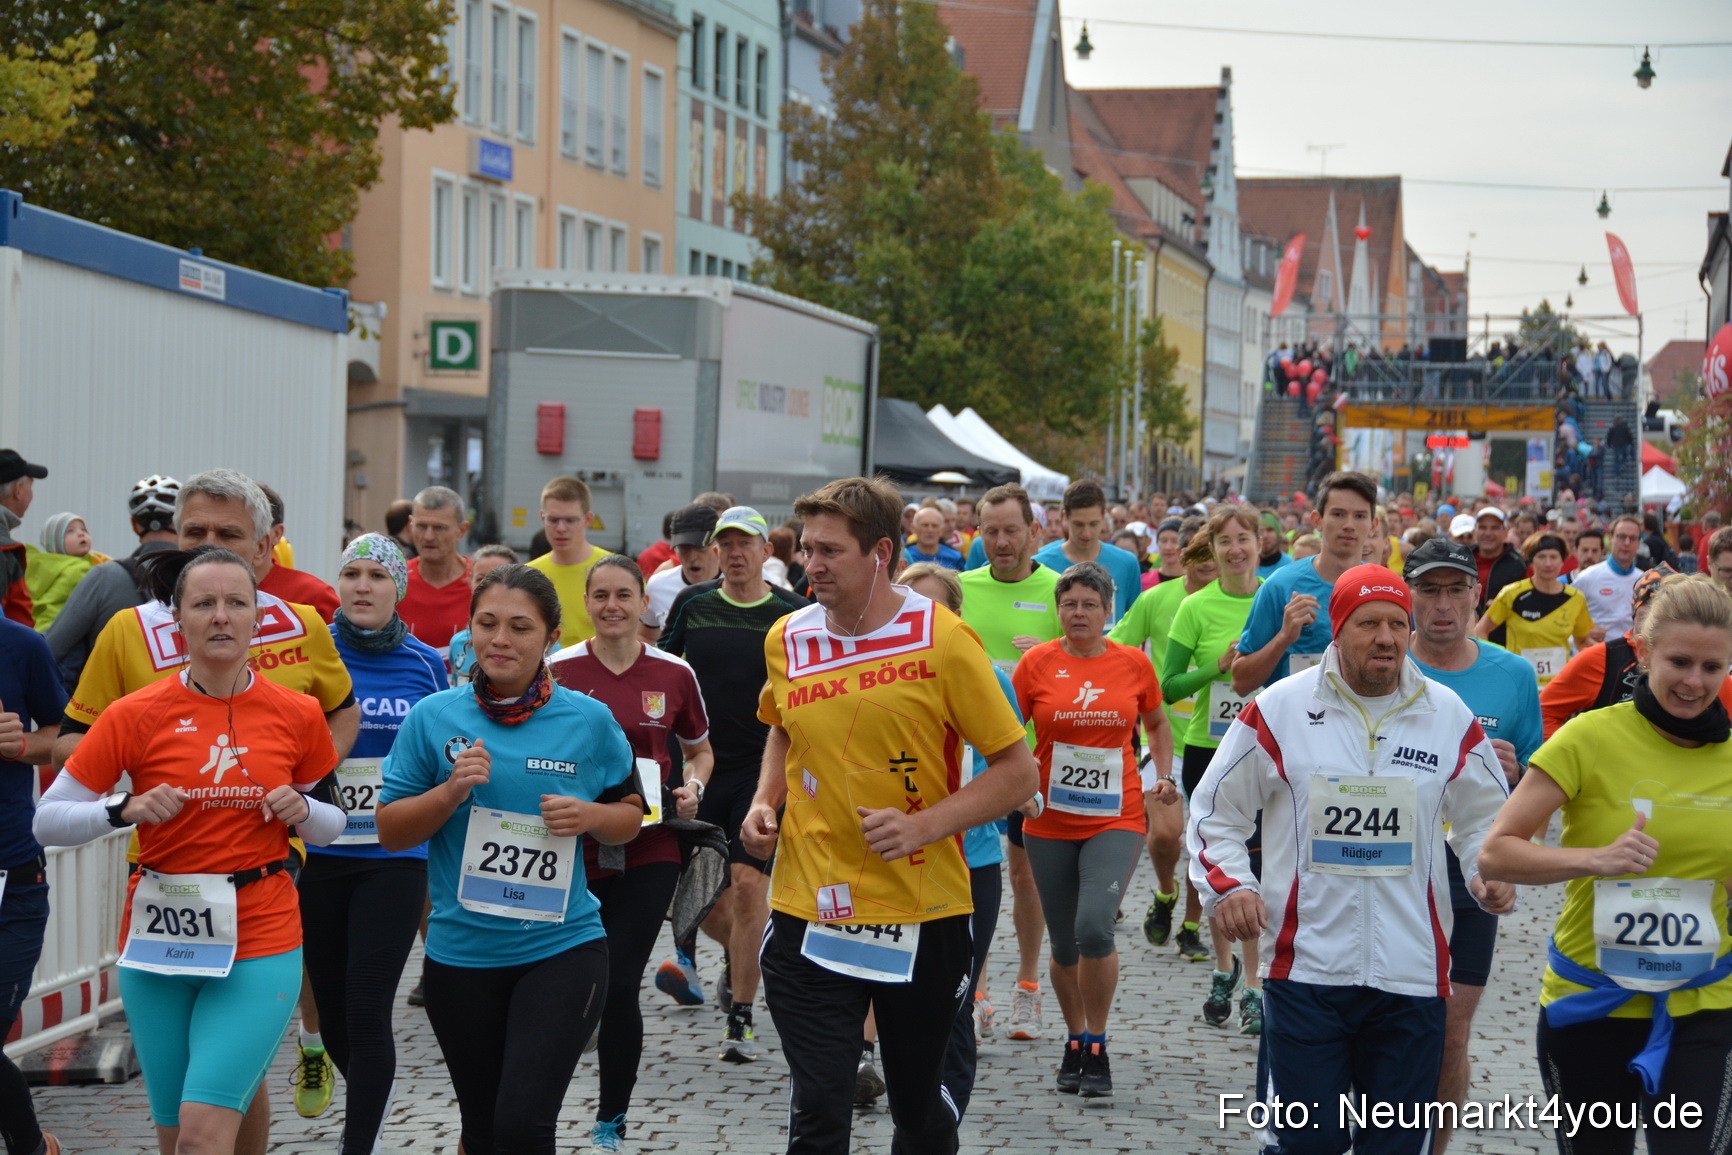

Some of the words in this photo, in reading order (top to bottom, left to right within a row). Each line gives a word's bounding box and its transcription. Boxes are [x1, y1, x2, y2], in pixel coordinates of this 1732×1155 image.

[437, 327, 473, 364] D
[822, 376, 863, 448] BOCK
[1425, 409, 1472, 427] ZIEL
[1449, 552, 1468, 561] 2XU
[1372, 585, 1404, 597] odlo
[787, 677, 849, 710] MAX
[859, 660, 937, 690] BÖGL
[355, 697, 411, 716] CAD
[1219, 701, 1250, 719] 23
[1053, 710, 1119, 722] funrunners
[1072, 717, 1127, 727] neumarkt
[1474, 715, 1499, 728] CK
[1393, 746, 1439, 767] JURA
[346, 765, 377, 774] BOCK
[526, 757, 577, 775] BOCK
[1391, 759, 1437, 774] SPORT-Service
[1060, 765, 1110, 790] 2231
[178, 786, 264, 800] unrunners
[1349, 785, 1387, 794] BOCK
[342, 784, 382, 811] 32
[1068, 793, 1102, 805] Michaela
[1324, 806, 1400, 837] 2244
[512, 822, 550, 837] BOCK
[1341, 846, 1383, 861] Rüdiger
[478, 841, 558, 882] 2378
[164, 884, 201, 894] BOCK
[502, 886, 525, 901] Lisa
[1644, 888, 1681, 898] BOCK
[146, 904, 215, 938] 2031
[824, 923, 903, 943] 44
[1614, 912, 1703, 947] 2202
[165, 947, 195, 960] Karin
[1637, 957, 1682, 972] Pamela
